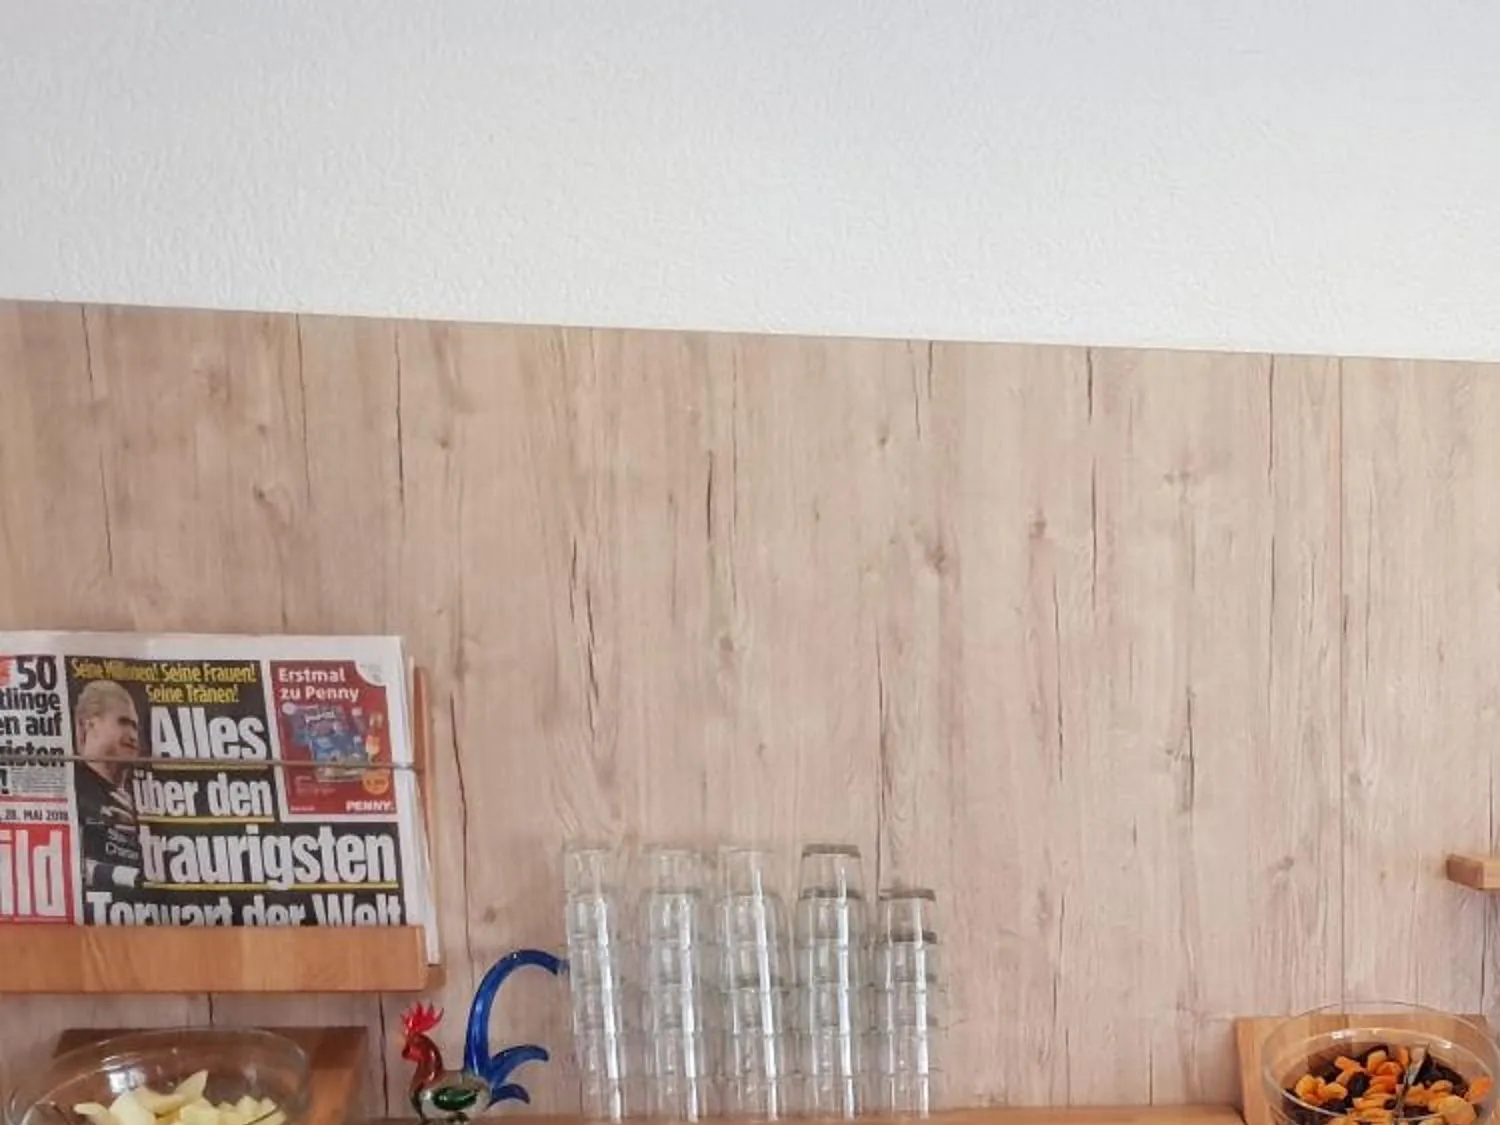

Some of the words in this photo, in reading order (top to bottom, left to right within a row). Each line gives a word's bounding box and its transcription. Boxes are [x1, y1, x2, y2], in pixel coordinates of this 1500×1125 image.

[16, 655, 57, 690] 50
[160, 663, 202, 682] Seine
[203, 663, 257, 683] Frauen!
[278, 667, 346, 683] Erstmal
[145, 684, 184, 703] Seine
[279, 688, 301, 699] zu
[305, 686, 359, 704] Penny
[25, 711, 62, 737] auf
[150, 705, 267, 763] Alles
[133, 770, 198, 817] über
[207, 771, 273, 817] den
[138, 824, 395, 891] traurigsten
[242, 895, 307, 926] der
[312, 894, 402, 926] Welt
